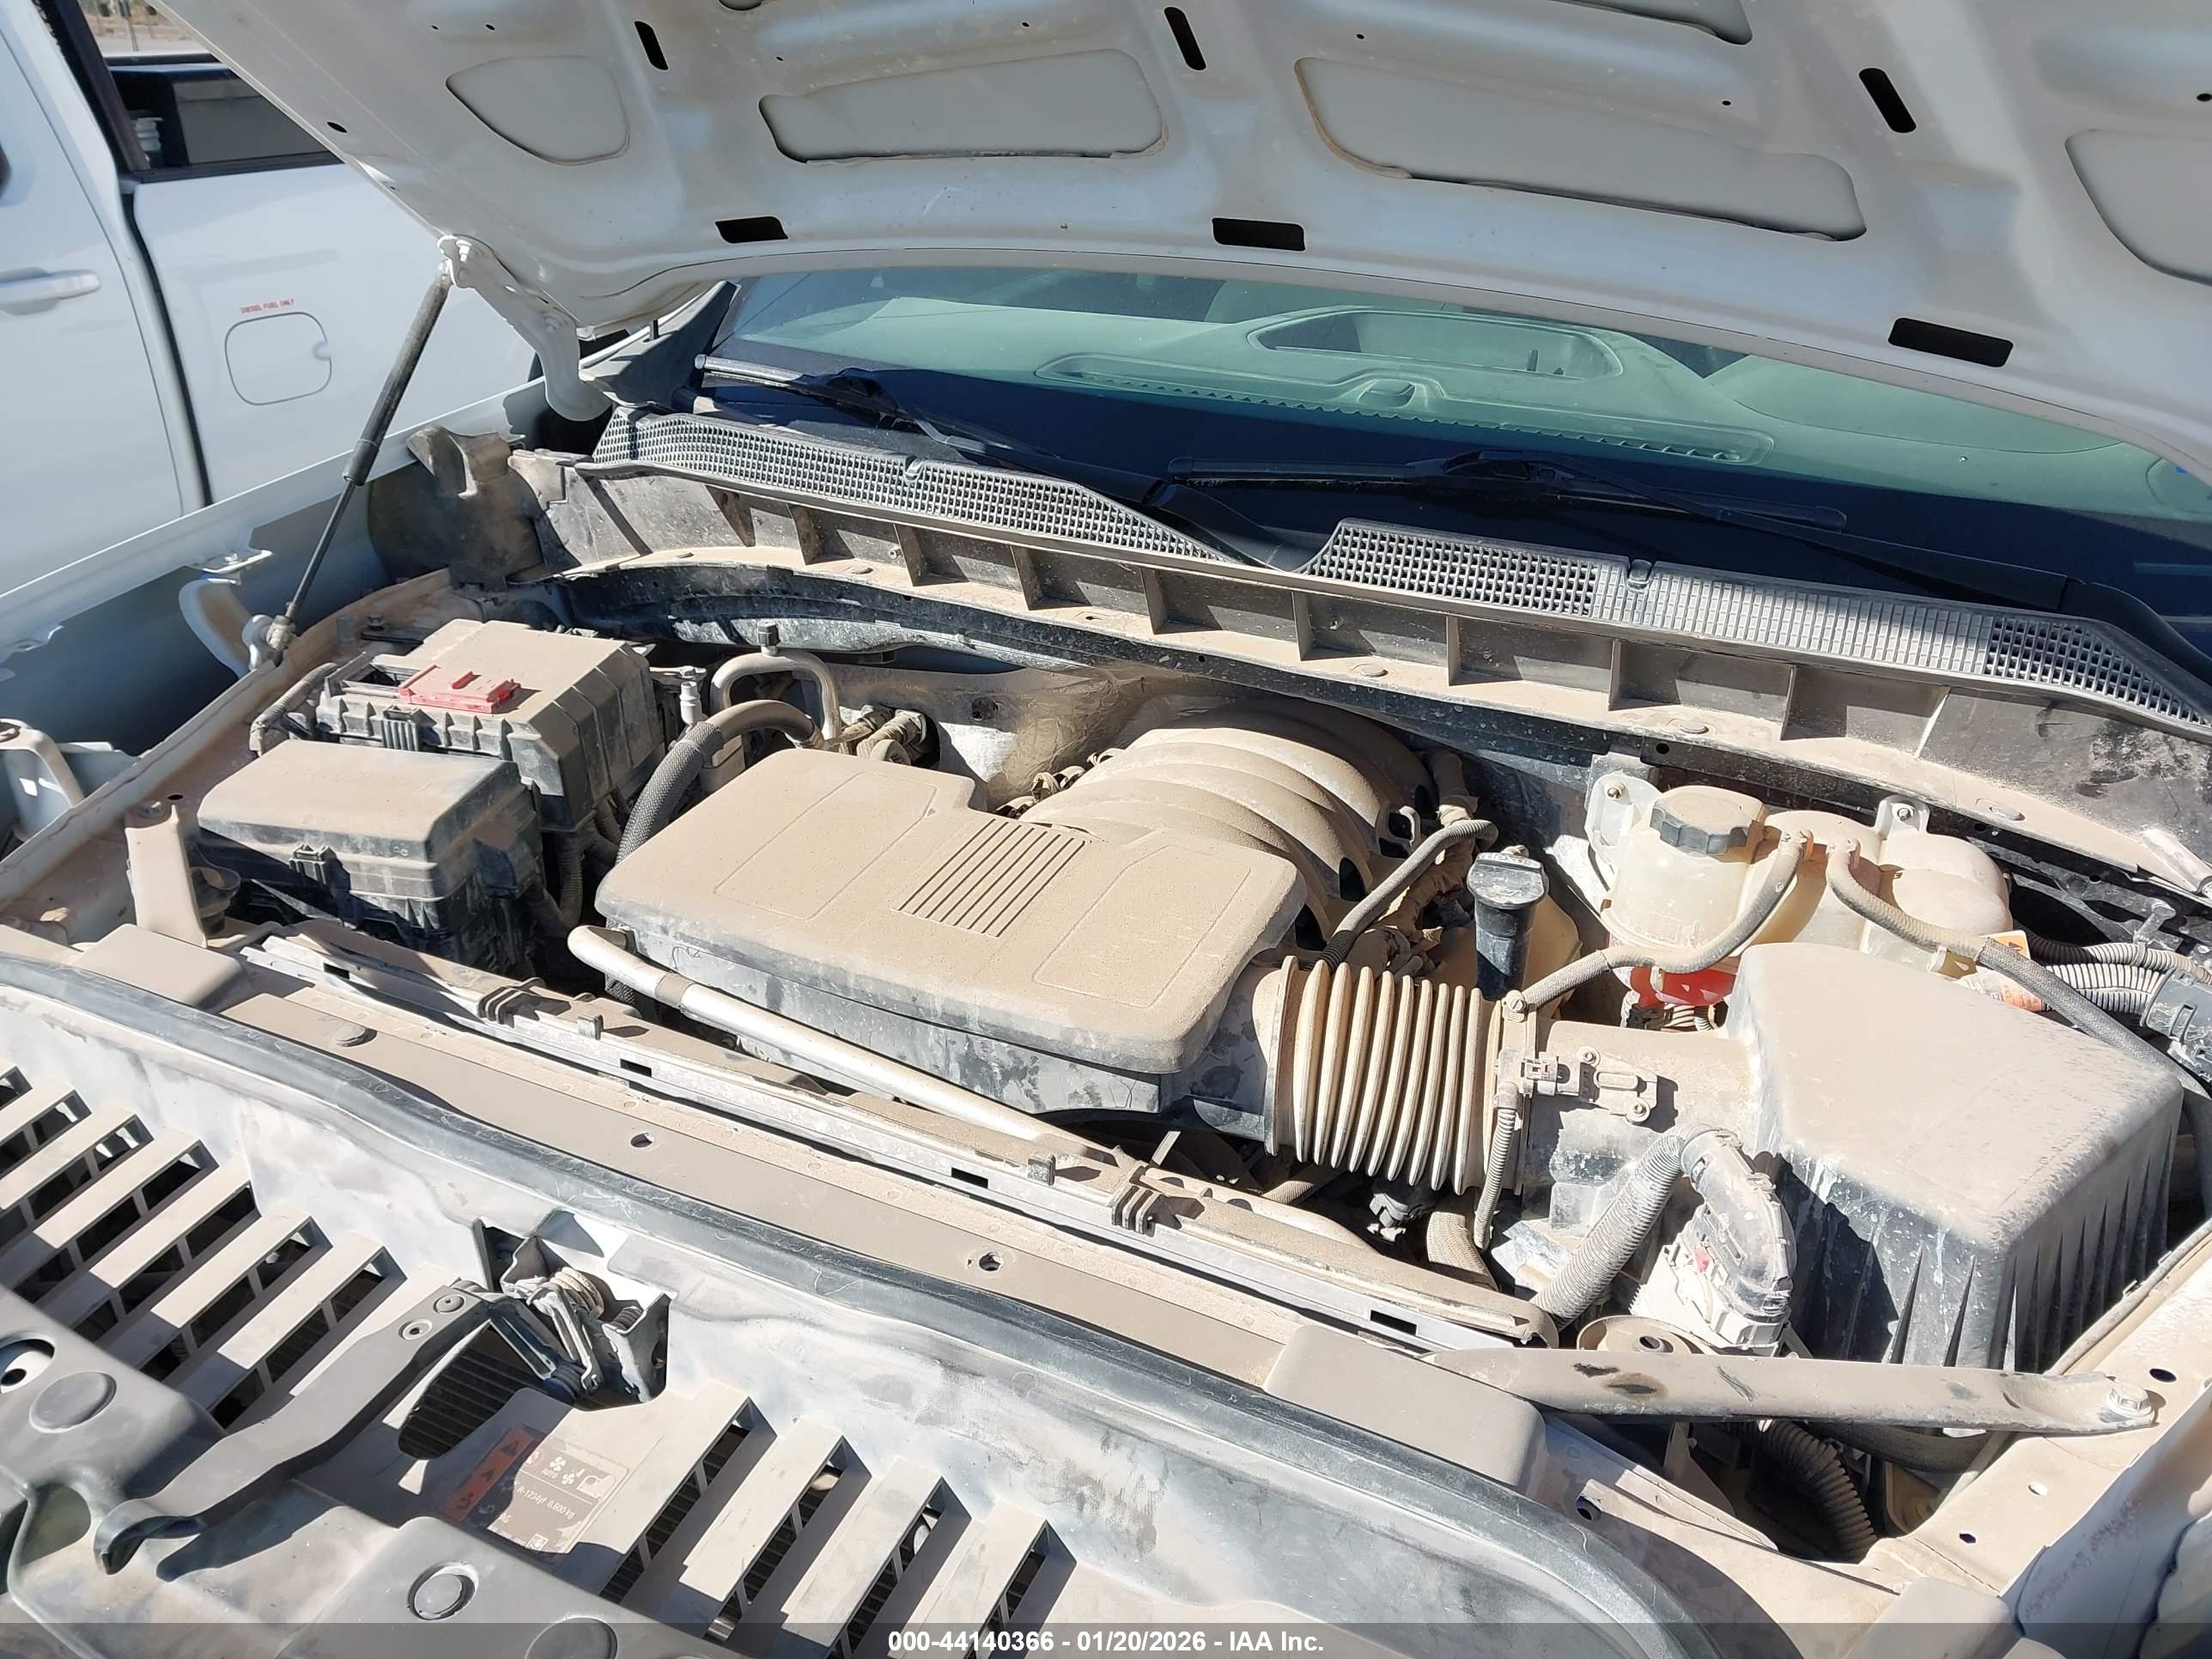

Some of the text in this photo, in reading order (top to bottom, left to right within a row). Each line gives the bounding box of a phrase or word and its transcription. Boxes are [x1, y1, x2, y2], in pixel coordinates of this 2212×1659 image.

[541, 1468, 558, 1479] AUTO
[517, 1486, 575, 1520] R-1234yf 0.600 kg
